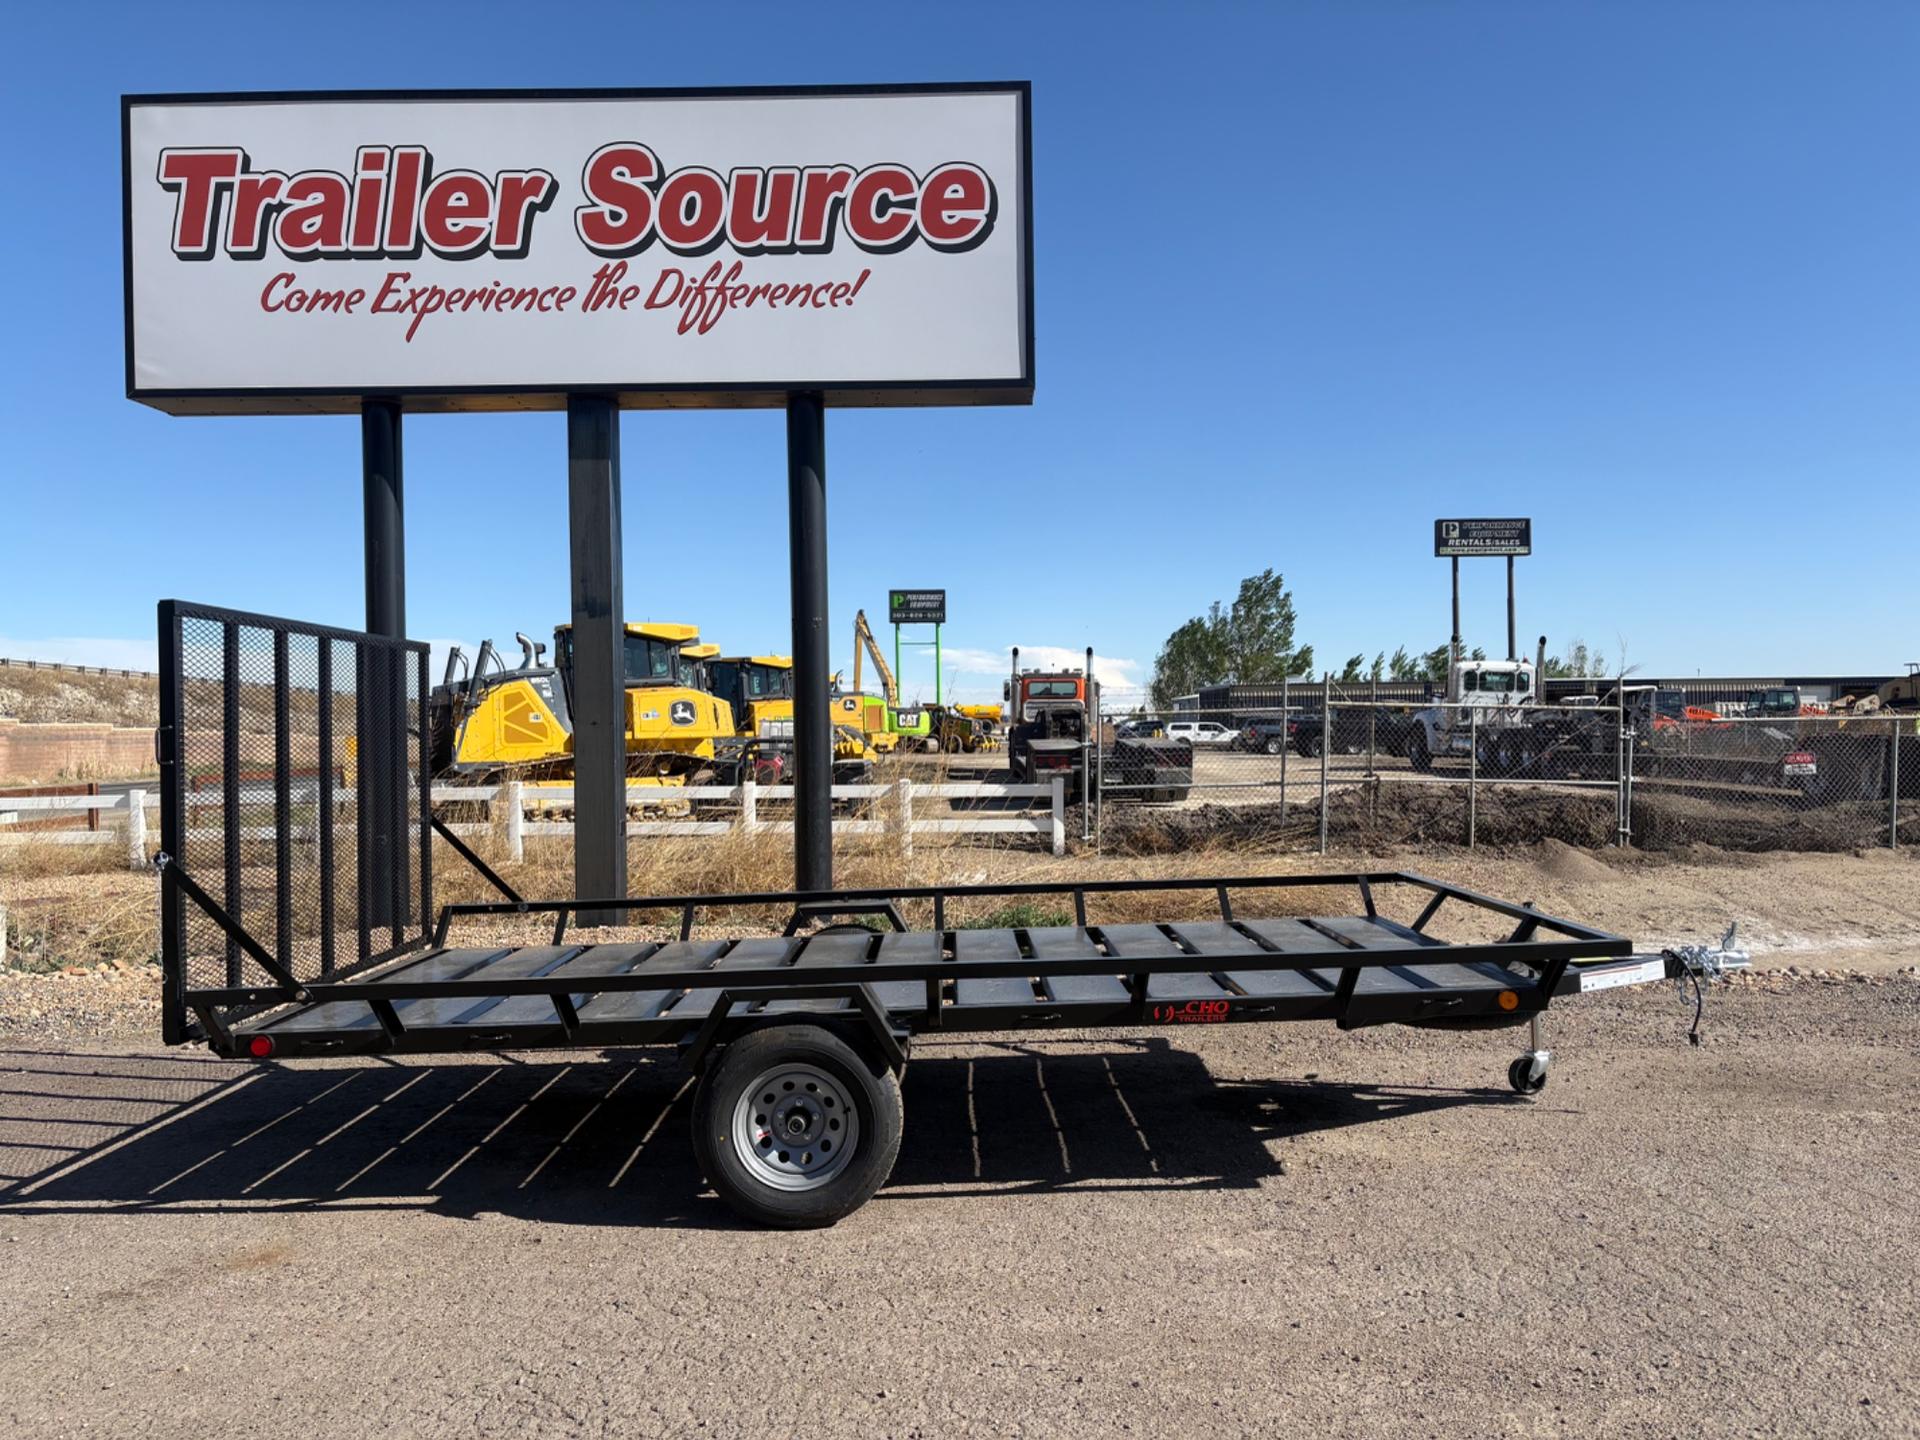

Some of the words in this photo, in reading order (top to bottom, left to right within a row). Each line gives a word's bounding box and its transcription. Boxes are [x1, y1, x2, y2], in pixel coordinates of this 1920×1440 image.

[157, 146, 559, 261] Trailer
[575, 142, 998, 258] Source
[261, 272, 365, 313] Come
[371, 272, 577, 342] Experience
[582, 260, 640, 311] the
[644, 260, 871, 336] Difference!
[899, 714, 918, 727] CAT
